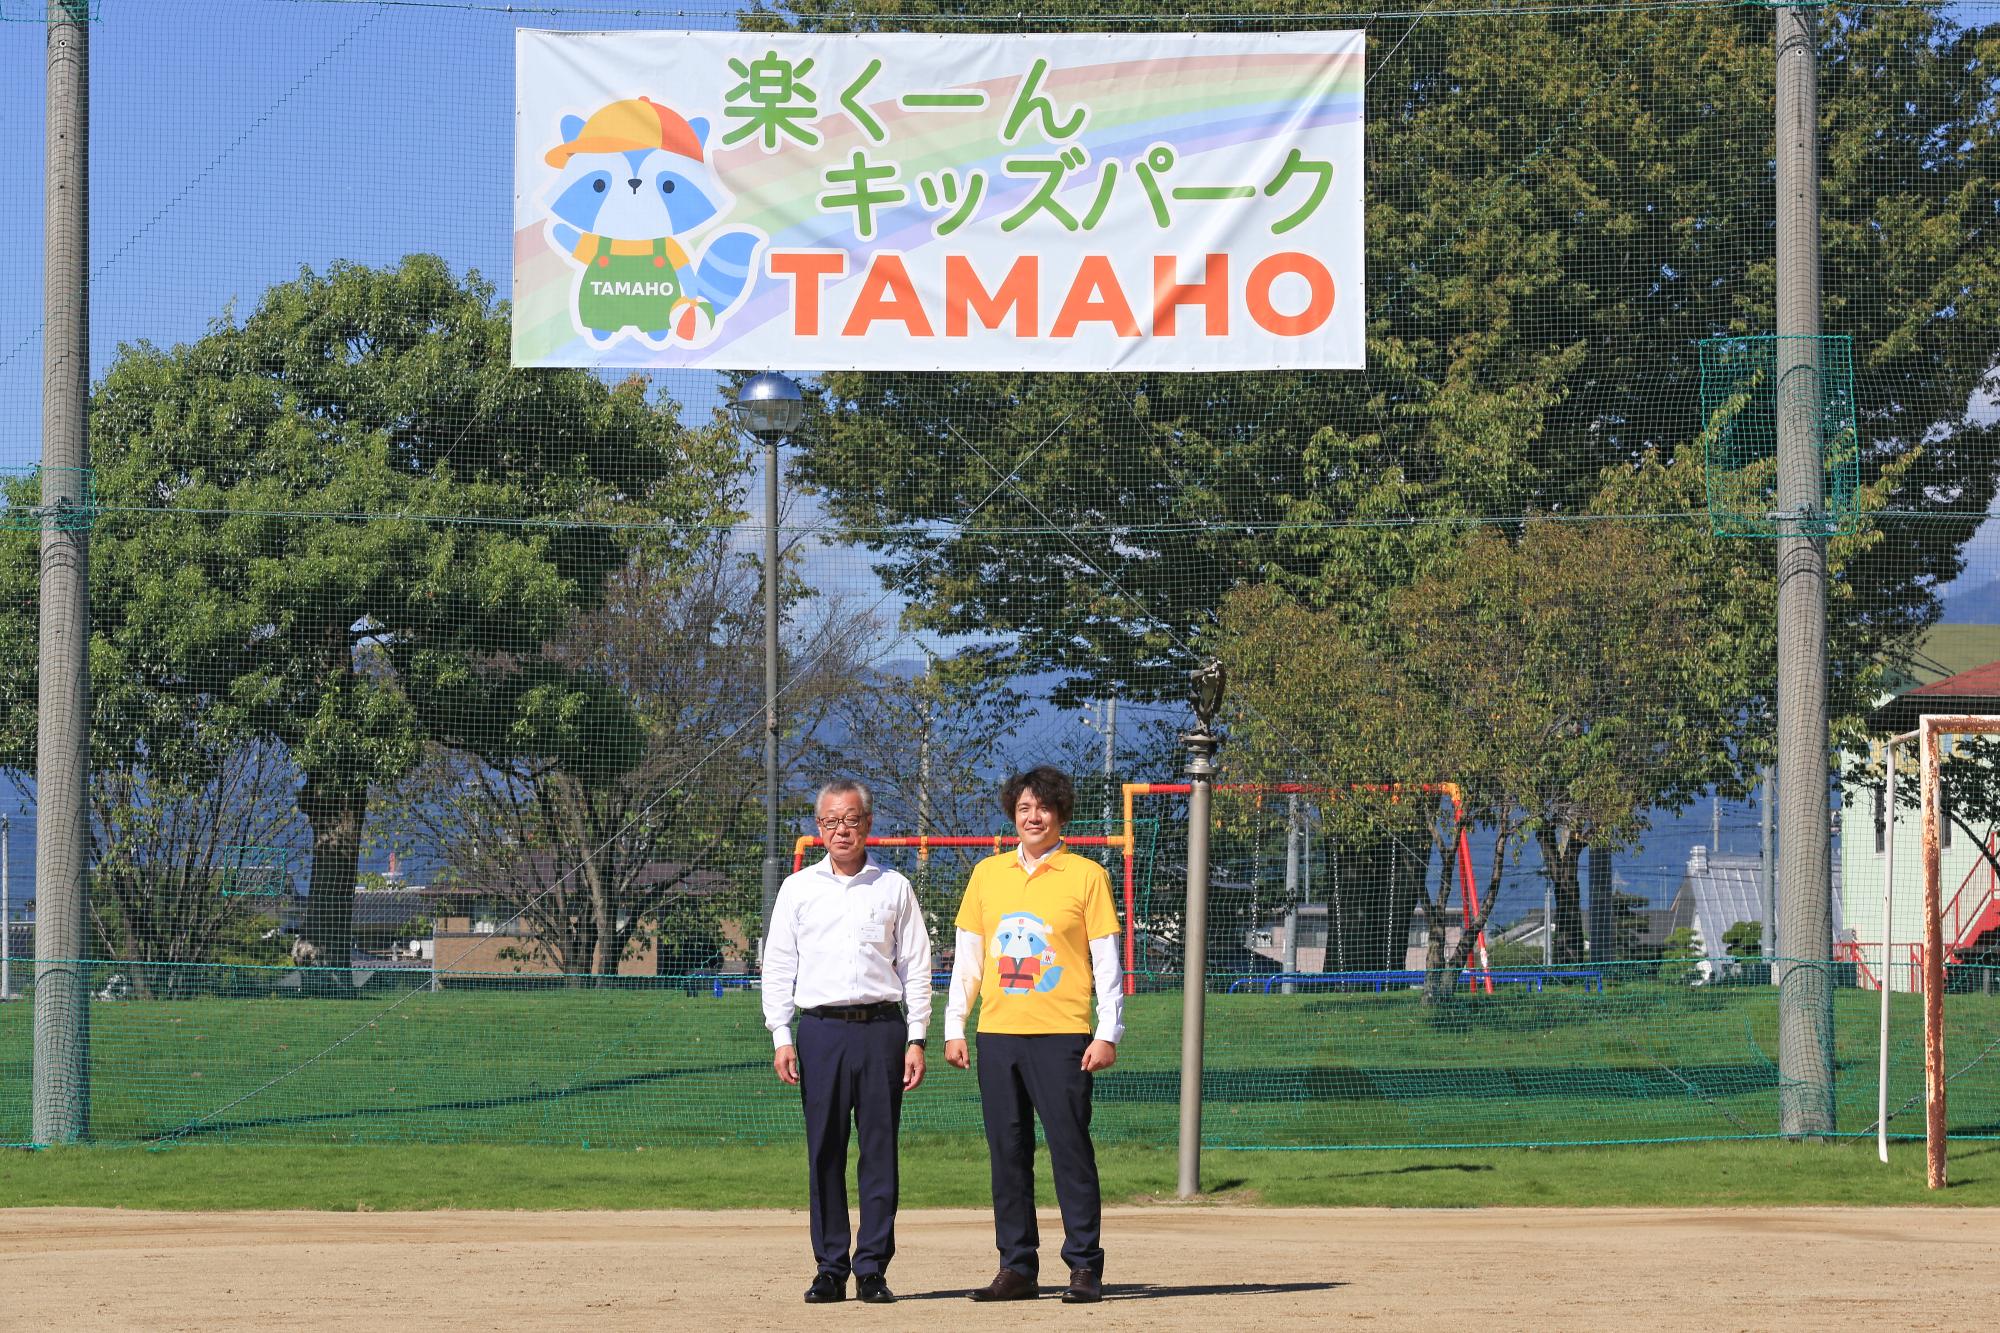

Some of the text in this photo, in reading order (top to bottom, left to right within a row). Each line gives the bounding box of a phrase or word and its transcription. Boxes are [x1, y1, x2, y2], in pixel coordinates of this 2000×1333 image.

[722, 50, 1086, 148] 楽くーん
[822, 147, 1333, 235] キッズパーク
[589, 279, 676, 298] TAMAHO
[771, 253, 1335, 337] TAMAHO
